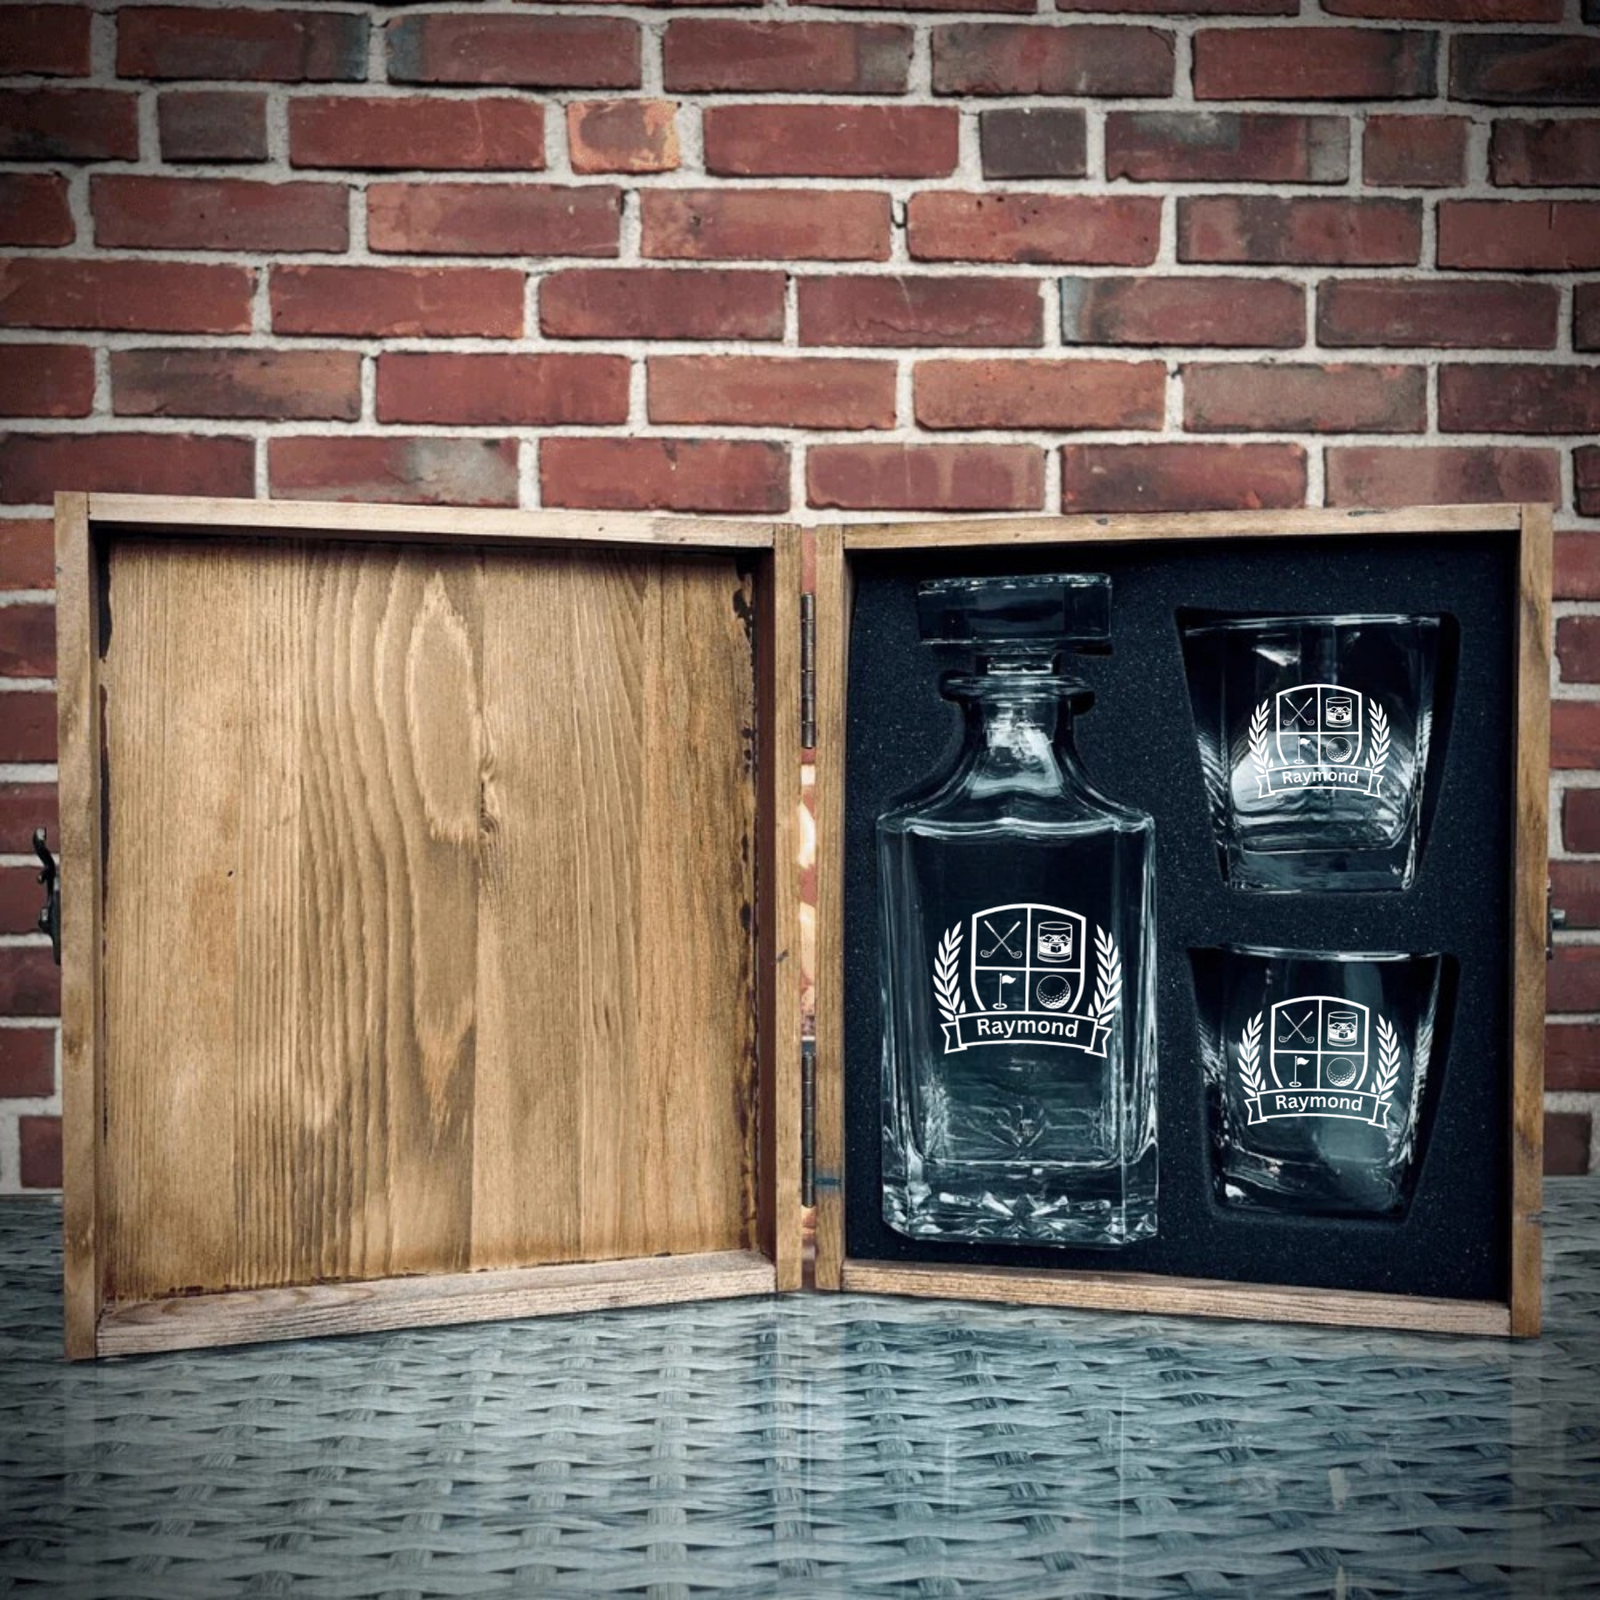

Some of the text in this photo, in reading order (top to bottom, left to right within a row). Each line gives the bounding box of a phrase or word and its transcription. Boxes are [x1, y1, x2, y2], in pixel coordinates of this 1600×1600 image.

[1282, 770, 1359, 786] Raymond
[976, 1018, 1079, 1038] Raymond
[1275, 1094, 1363, 1112] Raymond
